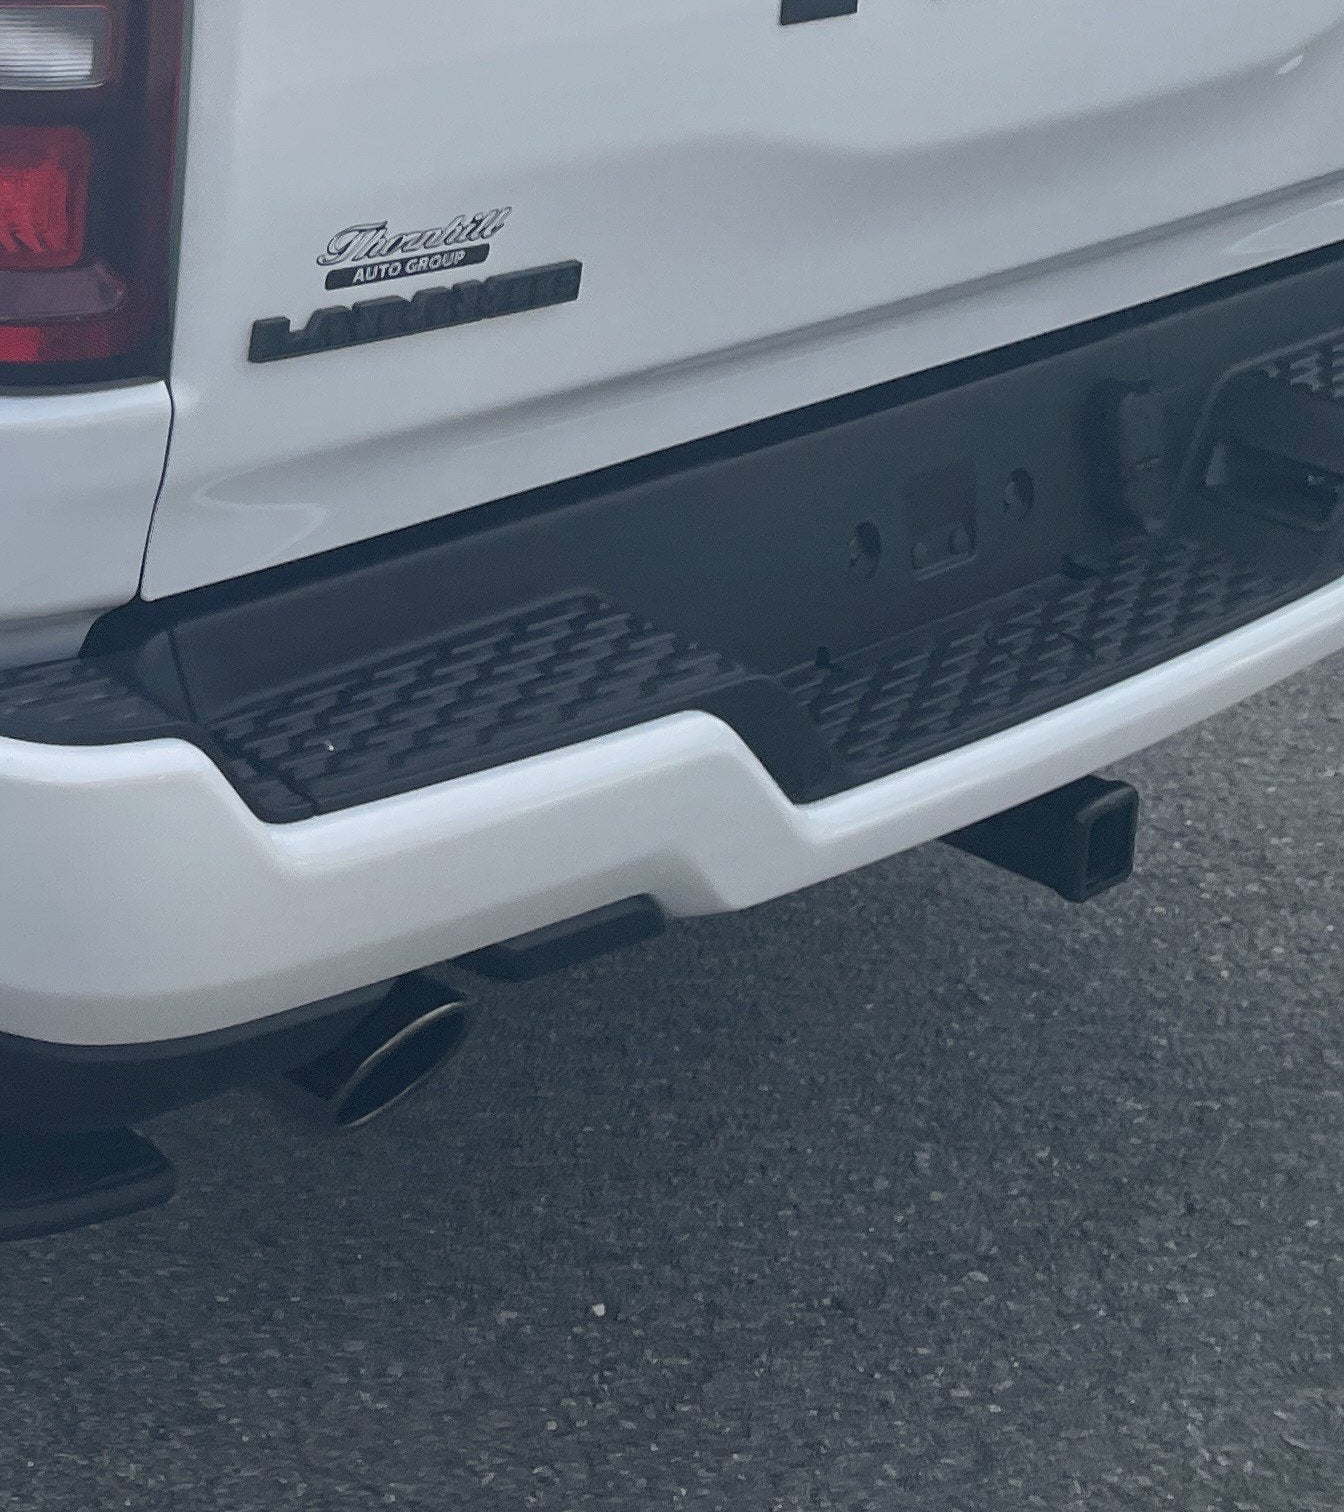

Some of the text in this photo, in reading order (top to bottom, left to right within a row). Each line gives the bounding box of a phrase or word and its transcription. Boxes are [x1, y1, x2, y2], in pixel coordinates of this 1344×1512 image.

[316, 206, 512, 266] Thornhill
[352, 250, 467, 284] AUTO GROUP
